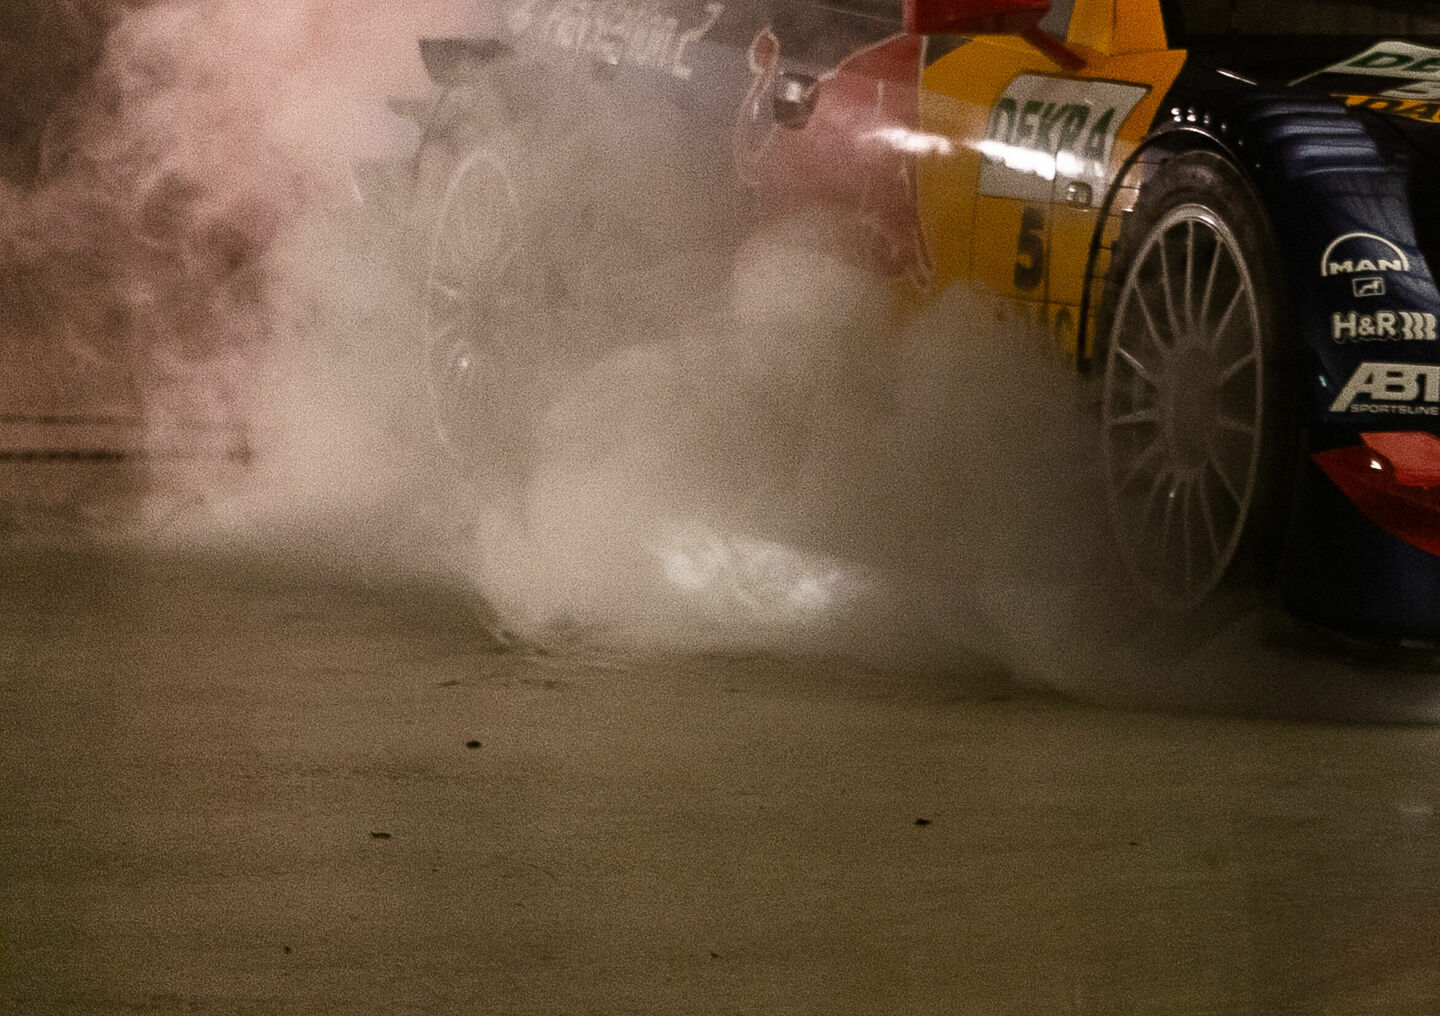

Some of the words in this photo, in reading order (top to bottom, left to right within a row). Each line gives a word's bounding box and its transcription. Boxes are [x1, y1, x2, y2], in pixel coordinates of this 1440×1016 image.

[1013, 206, 1044, 289] 5
[1328, 259, 1402, 275] MAN
[1332, 310, 1397, 340] H&R
[1350, 403, 1440, 416] SPORTSLINE
